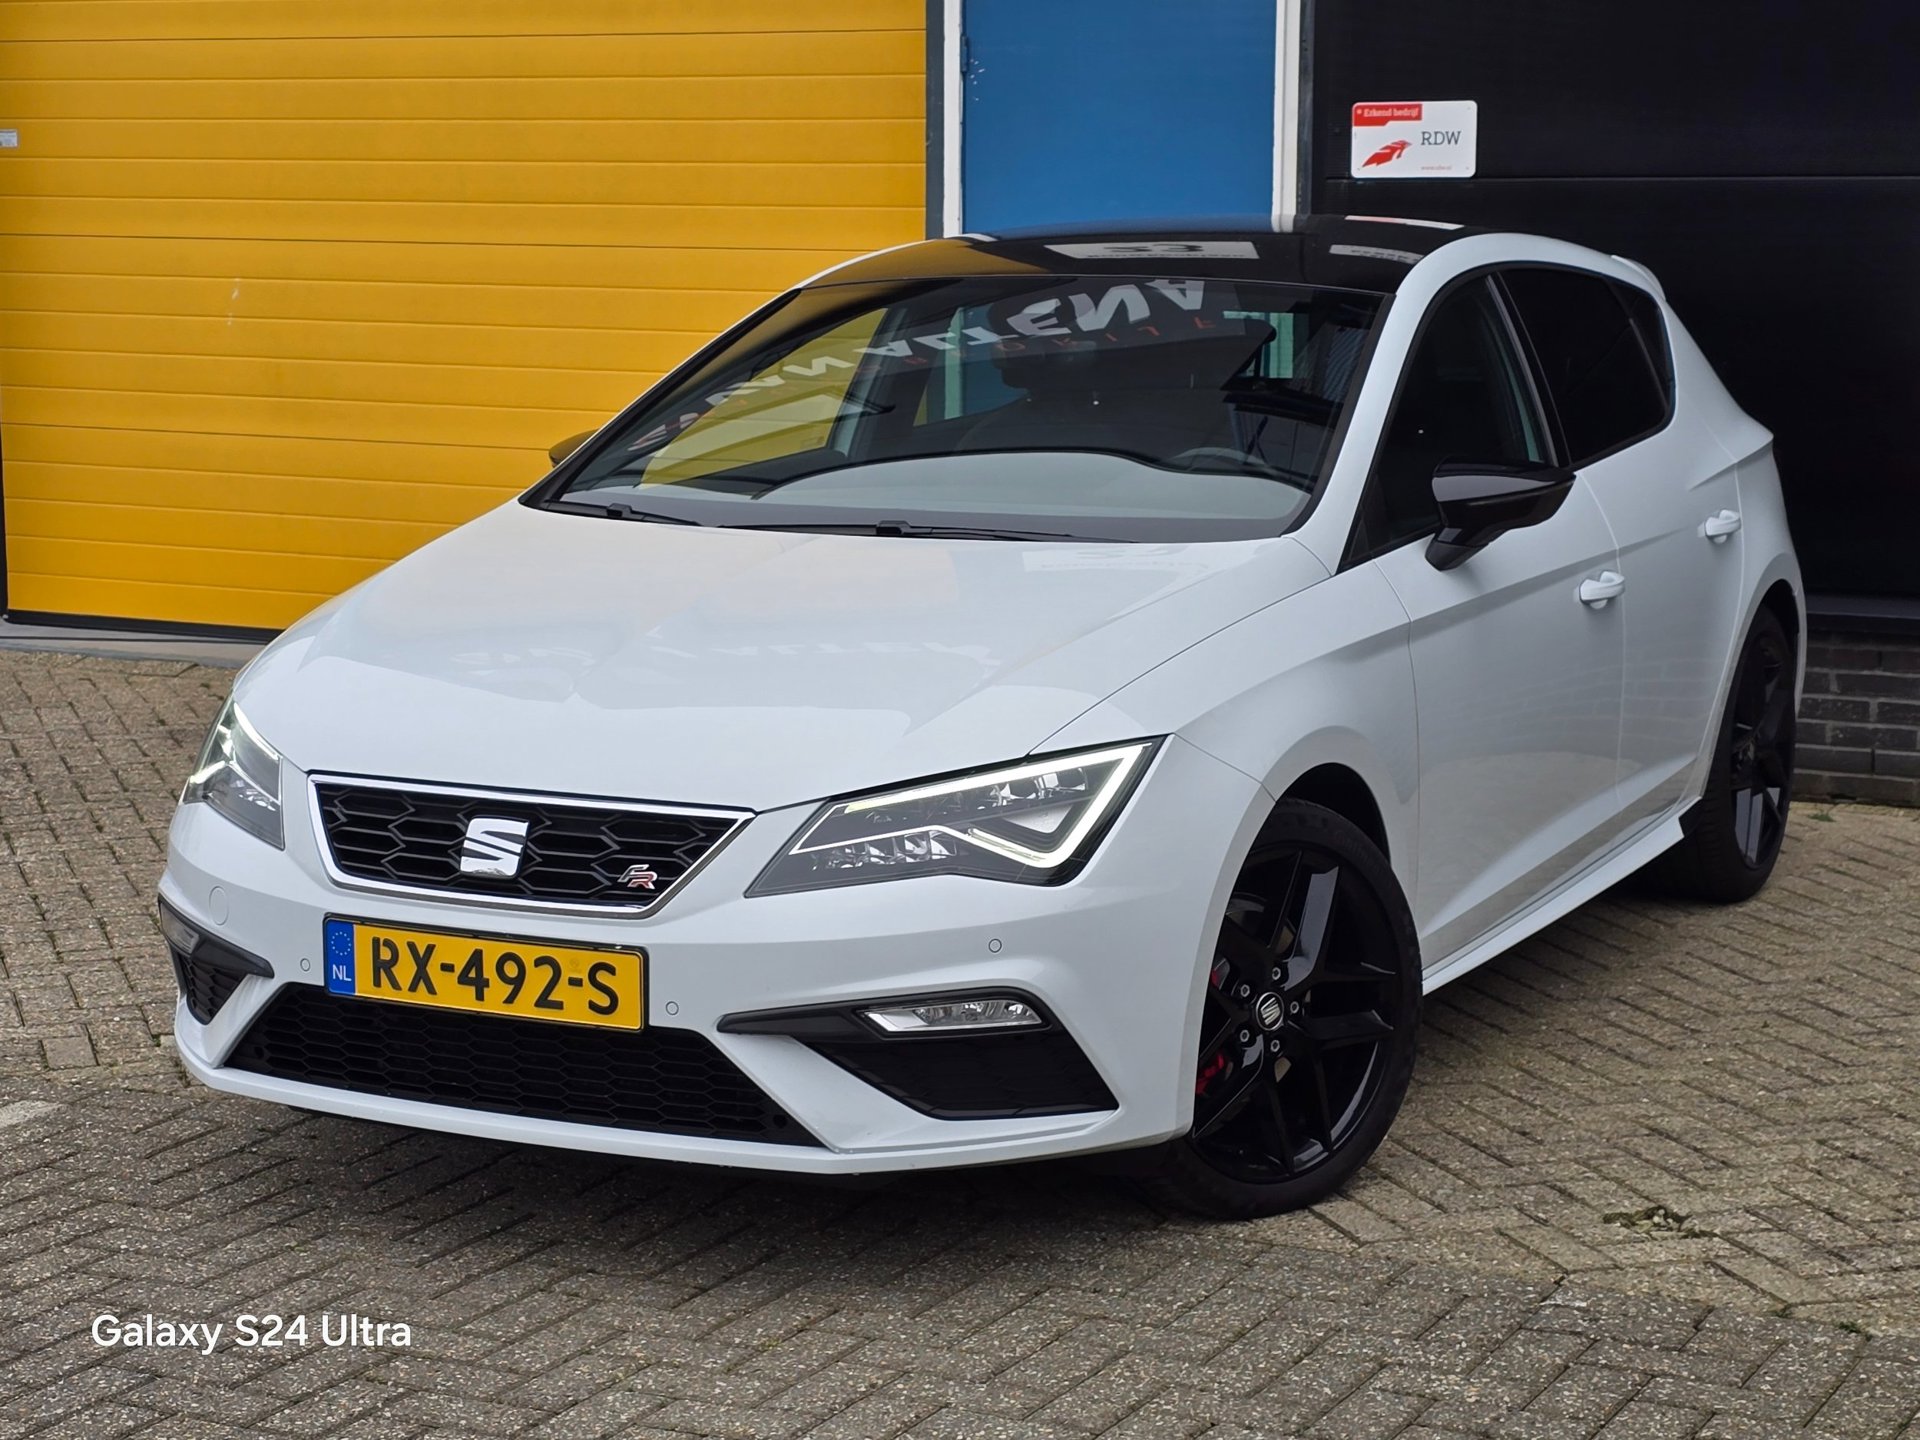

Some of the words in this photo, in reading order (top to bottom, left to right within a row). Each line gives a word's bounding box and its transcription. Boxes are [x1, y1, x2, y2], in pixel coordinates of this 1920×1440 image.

[1420, 130, 1462, 146] RDW
[617, 863, 658, 890] FR
[332, 963, 352, 982] NL
[371, 935, 620, 1016] RX-492-S
